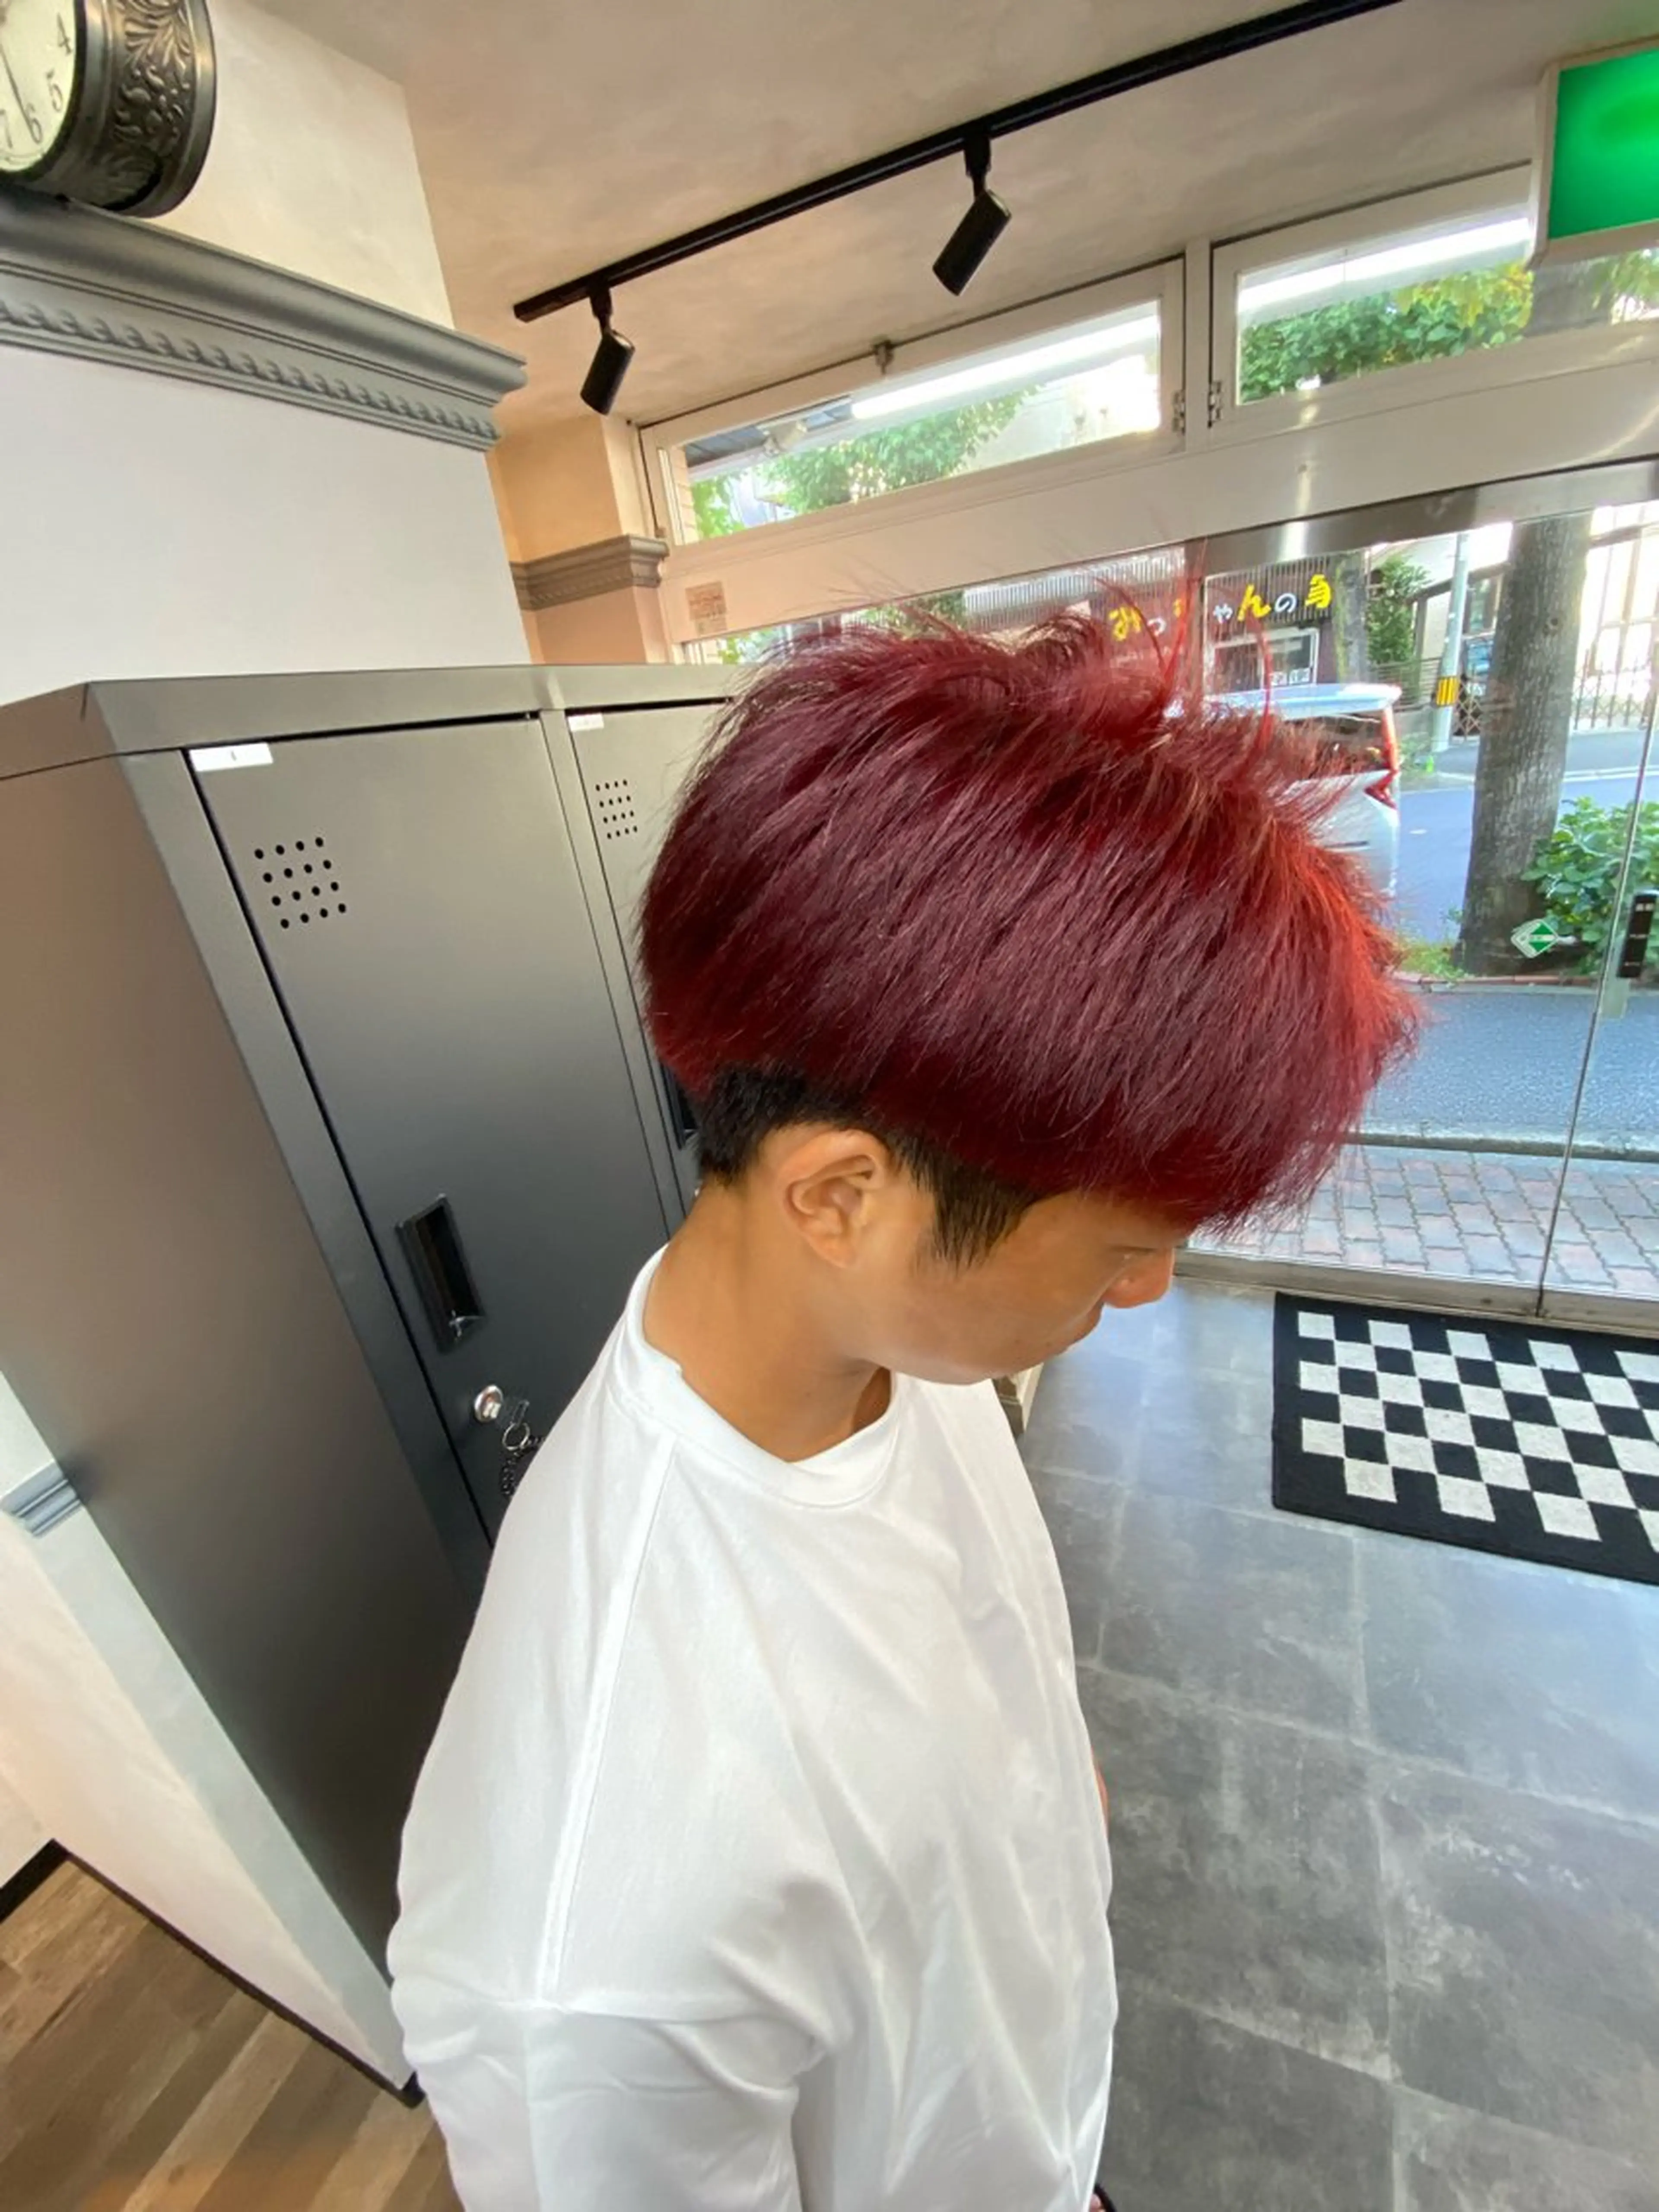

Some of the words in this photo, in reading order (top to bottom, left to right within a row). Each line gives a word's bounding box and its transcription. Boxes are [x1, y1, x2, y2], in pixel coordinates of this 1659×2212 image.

[56, 12, 72, 55] 4
[45, 67, 64, 112] 5
[24, 102, 43, 144] 6
